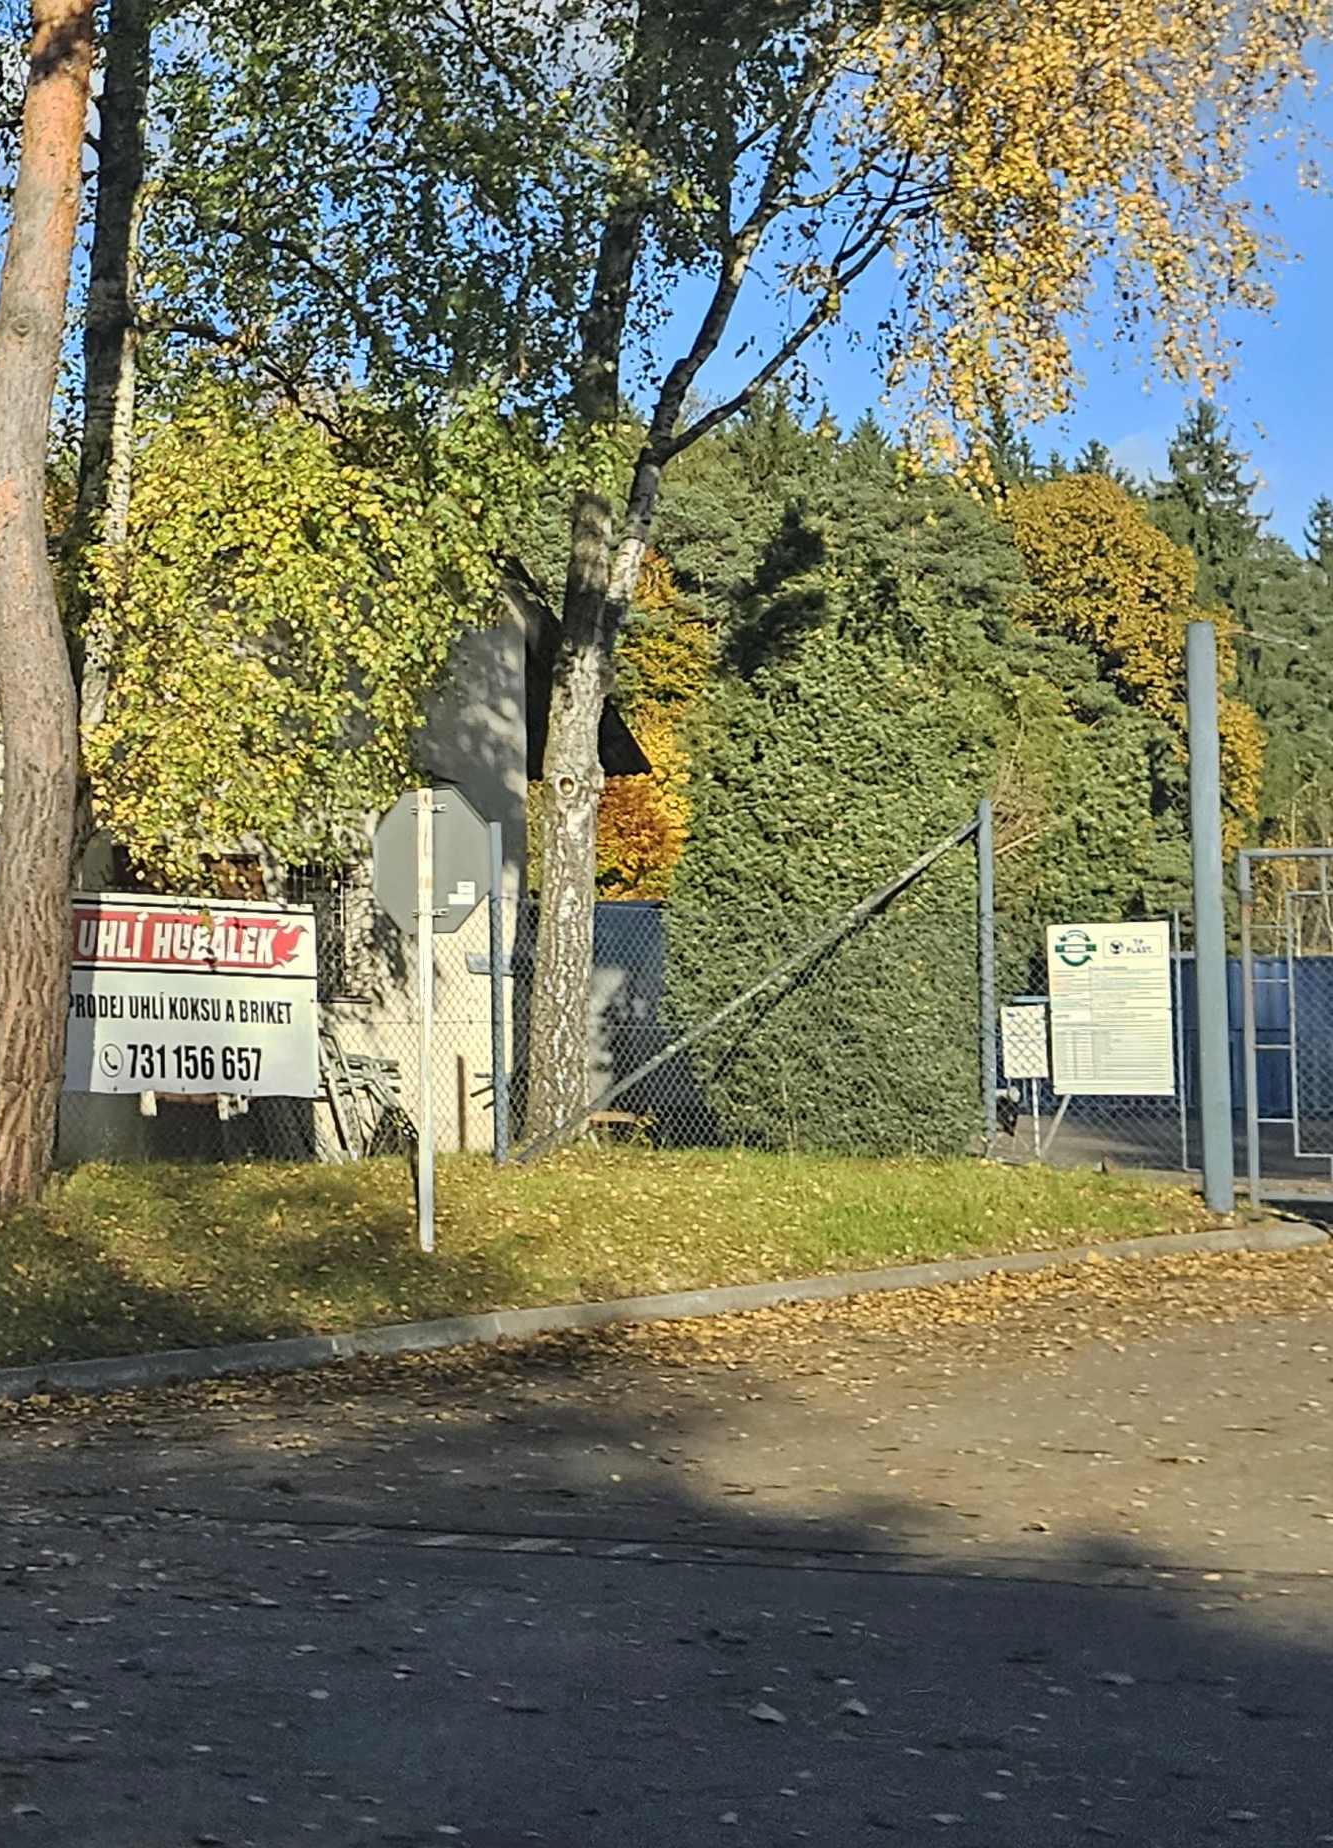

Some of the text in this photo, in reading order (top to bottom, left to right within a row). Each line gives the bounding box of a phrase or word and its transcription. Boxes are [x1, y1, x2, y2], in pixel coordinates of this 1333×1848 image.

[77, 911, 149, 958] UHLÍ
[128, 991, 165, 1020] UHLÍ
[169, 997, 221, 1022] KOKSU
[225, 1000, 235, 1022] A
[239, 1000, 292, 1024] BRIKET
[128, 1044, 262, 1081] 731 156 657
